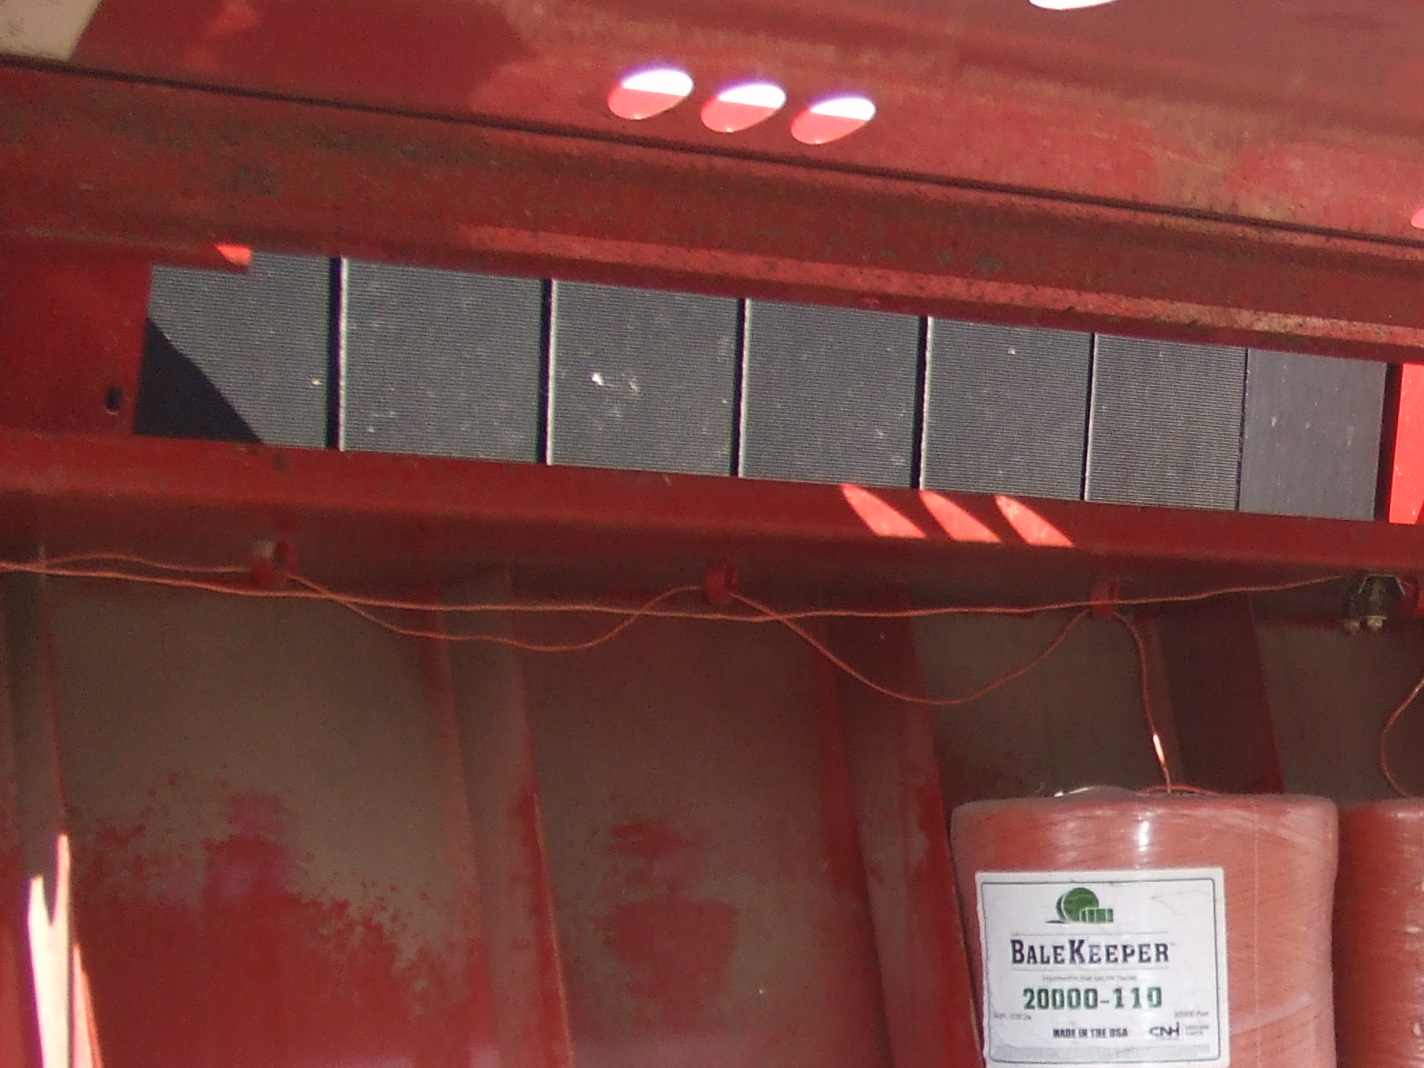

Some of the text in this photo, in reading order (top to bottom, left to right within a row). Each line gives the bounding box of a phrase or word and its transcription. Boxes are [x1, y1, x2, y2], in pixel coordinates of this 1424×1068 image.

[1023, 986, 1162, 1010] 20000-110
[1052, 1027, 1128, 1039] MADE IN THE USA
